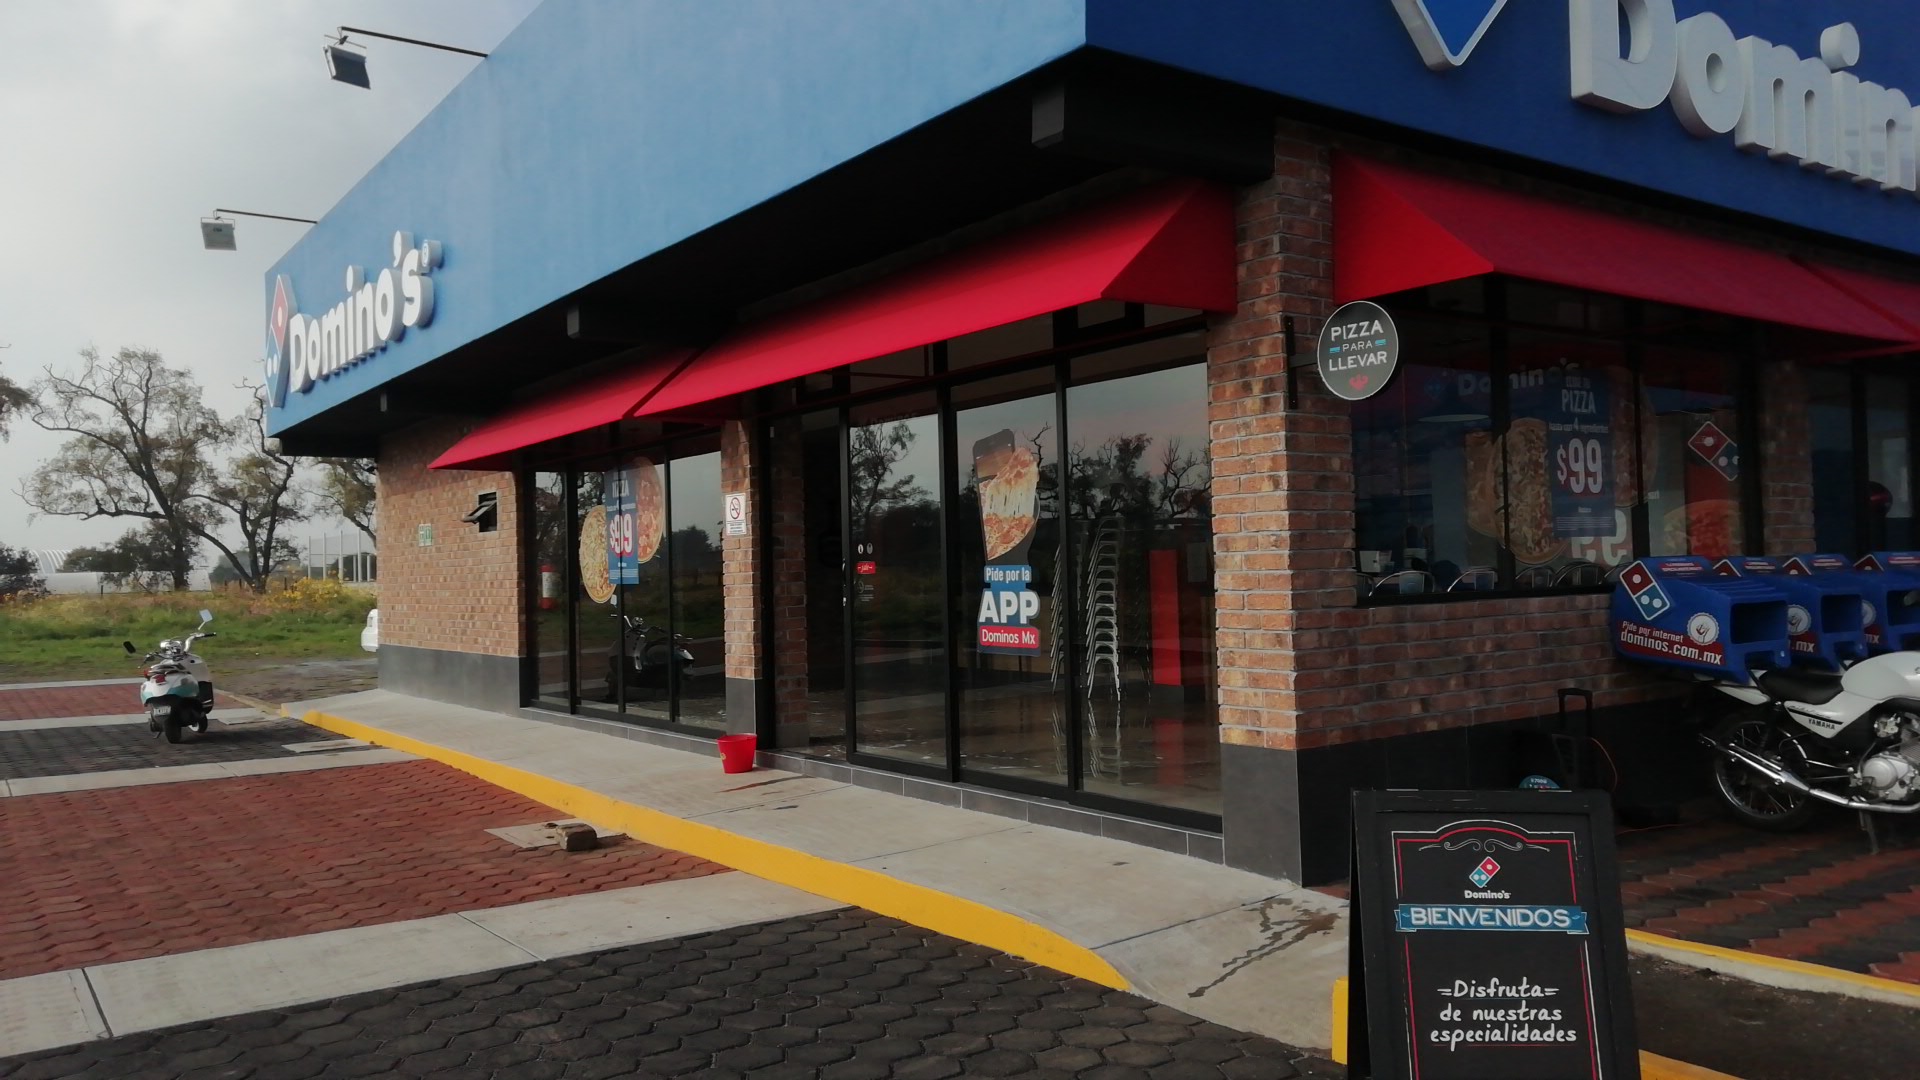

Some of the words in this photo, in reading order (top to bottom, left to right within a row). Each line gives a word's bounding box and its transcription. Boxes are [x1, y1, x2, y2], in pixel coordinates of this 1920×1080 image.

[1569, 0, 1920, 202] Domin
[290, 230, 434, 394] Domino's
[1331, 319, 1384, 341] PIZZA
[1342, 340, 1373, 352] PARA
[1329, 350, 1387, 371] LLEVAR
[1561, 388, 1597, 414] PIZZA
[1556, 438, 1603, 494] $99
[986, 567, 1004, 581] Pide
[1005, 569, 1020, 584] por
[1021, 567, 1030, 581] la
[979, 590, 1039, 624] APP
[981, 629, 1020, 643] Dominos
[1021, 630, 1036, 645] Mx
[1622, 620, 1637, 632] Pide
[1638, 626, 1650, 637] por
[1652, 628, 1684, 643] internet
[1620, 628, 1722, 665] dominos.com.mx
[1808, 718, 1835, 730] YAMAHA
[1464, 889, 1510, 899] Domino's
[1410, 907, 1571, 927] BIENVENIDOS
[1453, 976, 1544, 998] Disfruta
[1439, 1002, 1462, 1021] de
[1472, 1000, 1563, 1021] nuestras
[1430, 1023, 1577, 1051] especialidades
